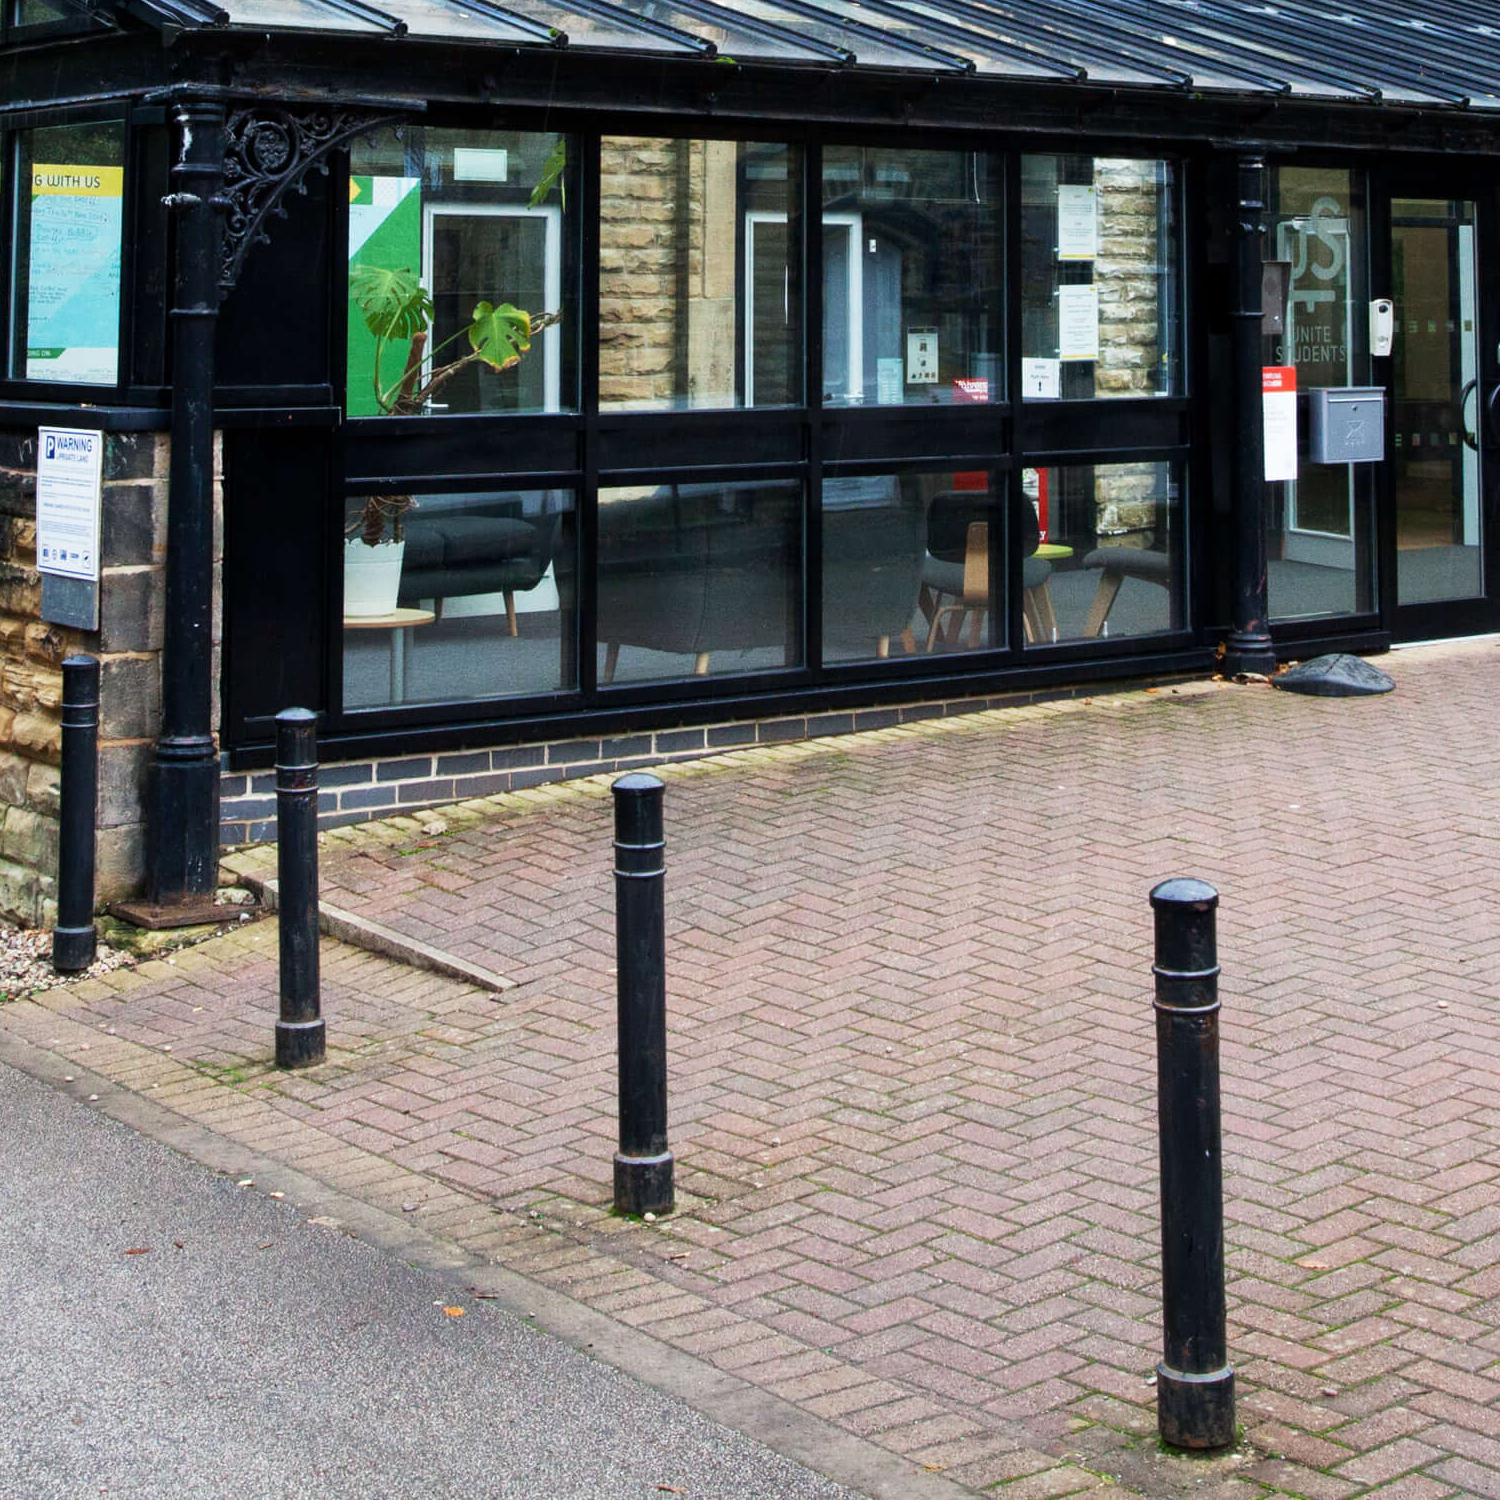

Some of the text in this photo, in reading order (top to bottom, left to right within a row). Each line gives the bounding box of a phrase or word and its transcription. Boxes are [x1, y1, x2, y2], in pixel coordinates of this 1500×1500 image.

[47, 175, 80, 187] WITH
[85, 176, 101, 188] US
[1292, 325, 1332, 343] UNITE
[57, 436, 93, 453] WARNING
